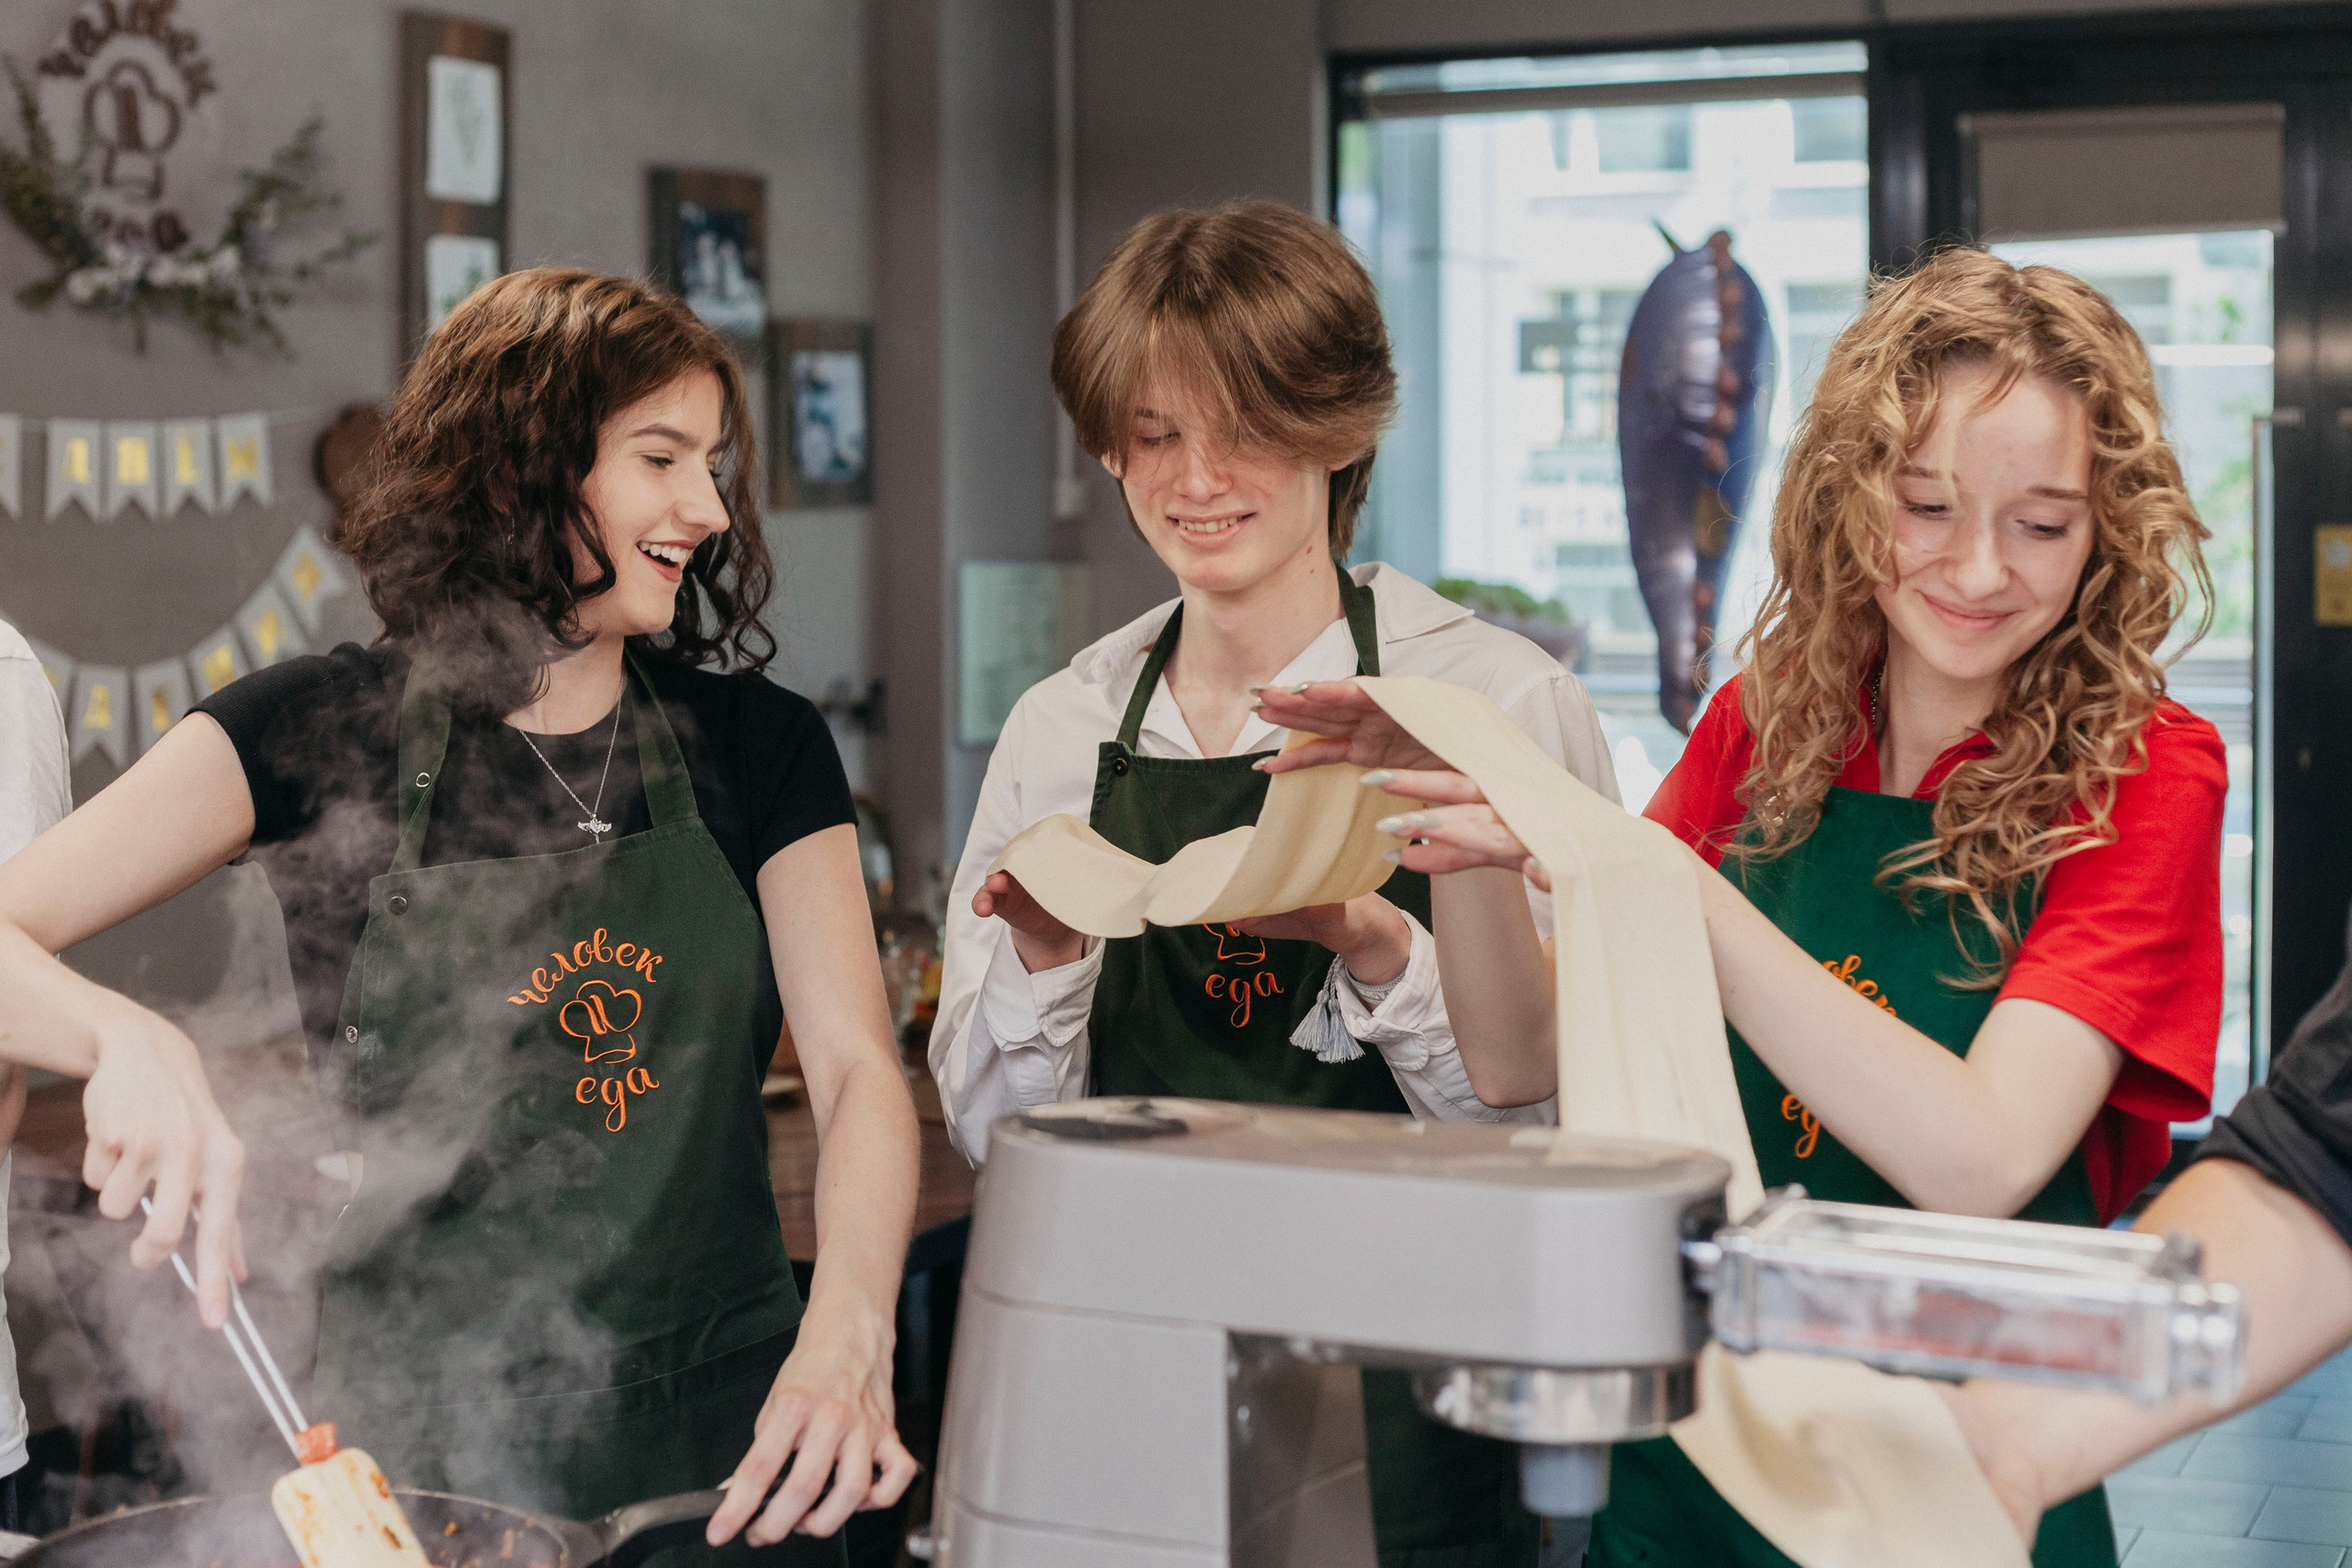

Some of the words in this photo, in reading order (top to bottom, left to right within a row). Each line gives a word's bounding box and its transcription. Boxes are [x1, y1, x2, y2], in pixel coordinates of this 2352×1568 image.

[507, 927, 663, 1006] человек
[1205, 971, 1284, 1028] еда
[575, 1066, 660, 1133] еда
[1781, 1093, 1820, 1159] ед
